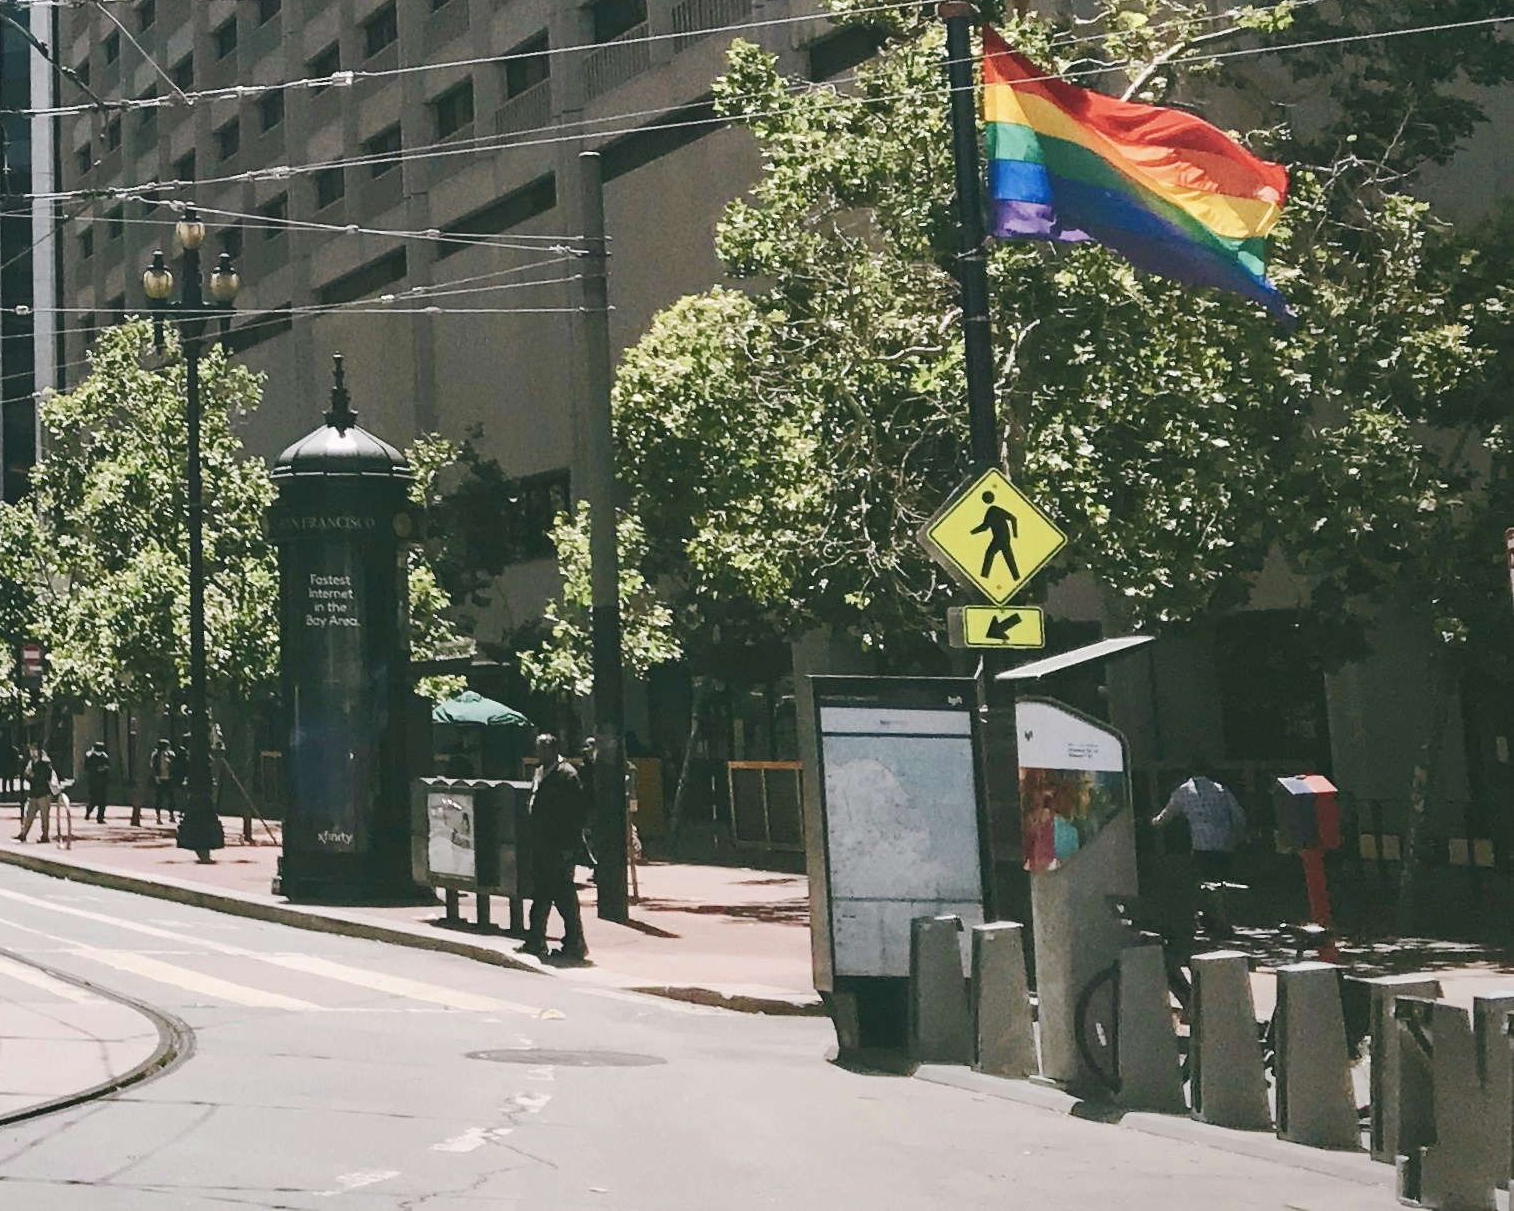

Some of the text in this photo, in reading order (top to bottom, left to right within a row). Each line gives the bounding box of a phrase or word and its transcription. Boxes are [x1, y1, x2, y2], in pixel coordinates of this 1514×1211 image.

[310, 574, 352, 586] Fastest
[308, 588, 354, 600] Internet
[314, 602, 347, 612] in the
[306, 615, 361, 628] Bay Area.
[317, 830, 354, 845] xfinity
